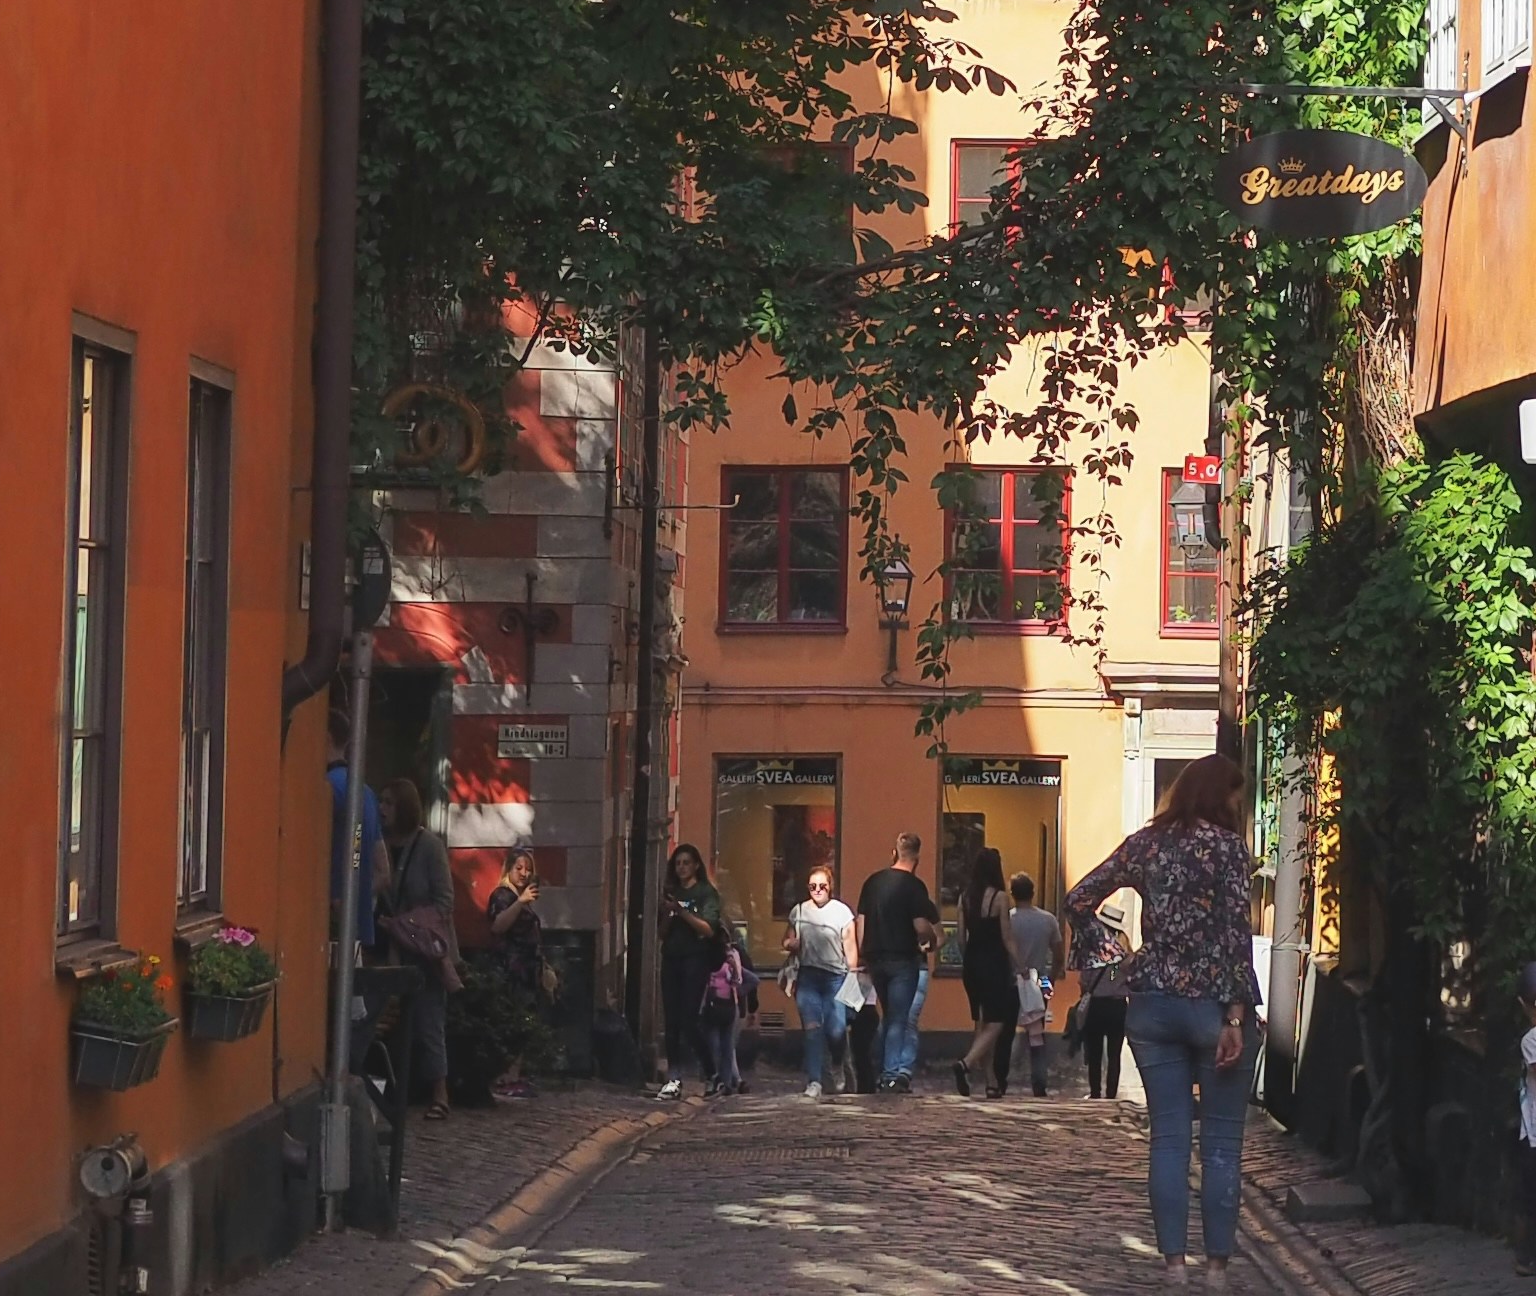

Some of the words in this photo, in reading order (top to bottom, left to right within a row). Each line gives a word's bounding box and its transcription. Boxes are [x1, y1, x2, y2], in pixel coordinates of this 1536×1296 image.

[1239, 164, 1405, 205] Greatdays
[718, 775, 755, 784] GALLERI
[756, 771, 794, 784] SVEA
[795, 775, 835, 784] GALLERY
[944, 775, 980, 784] GLERI
[981, 771, 1019, 784] SVEA
[1020, 776, 1060, 786] GALLERY
